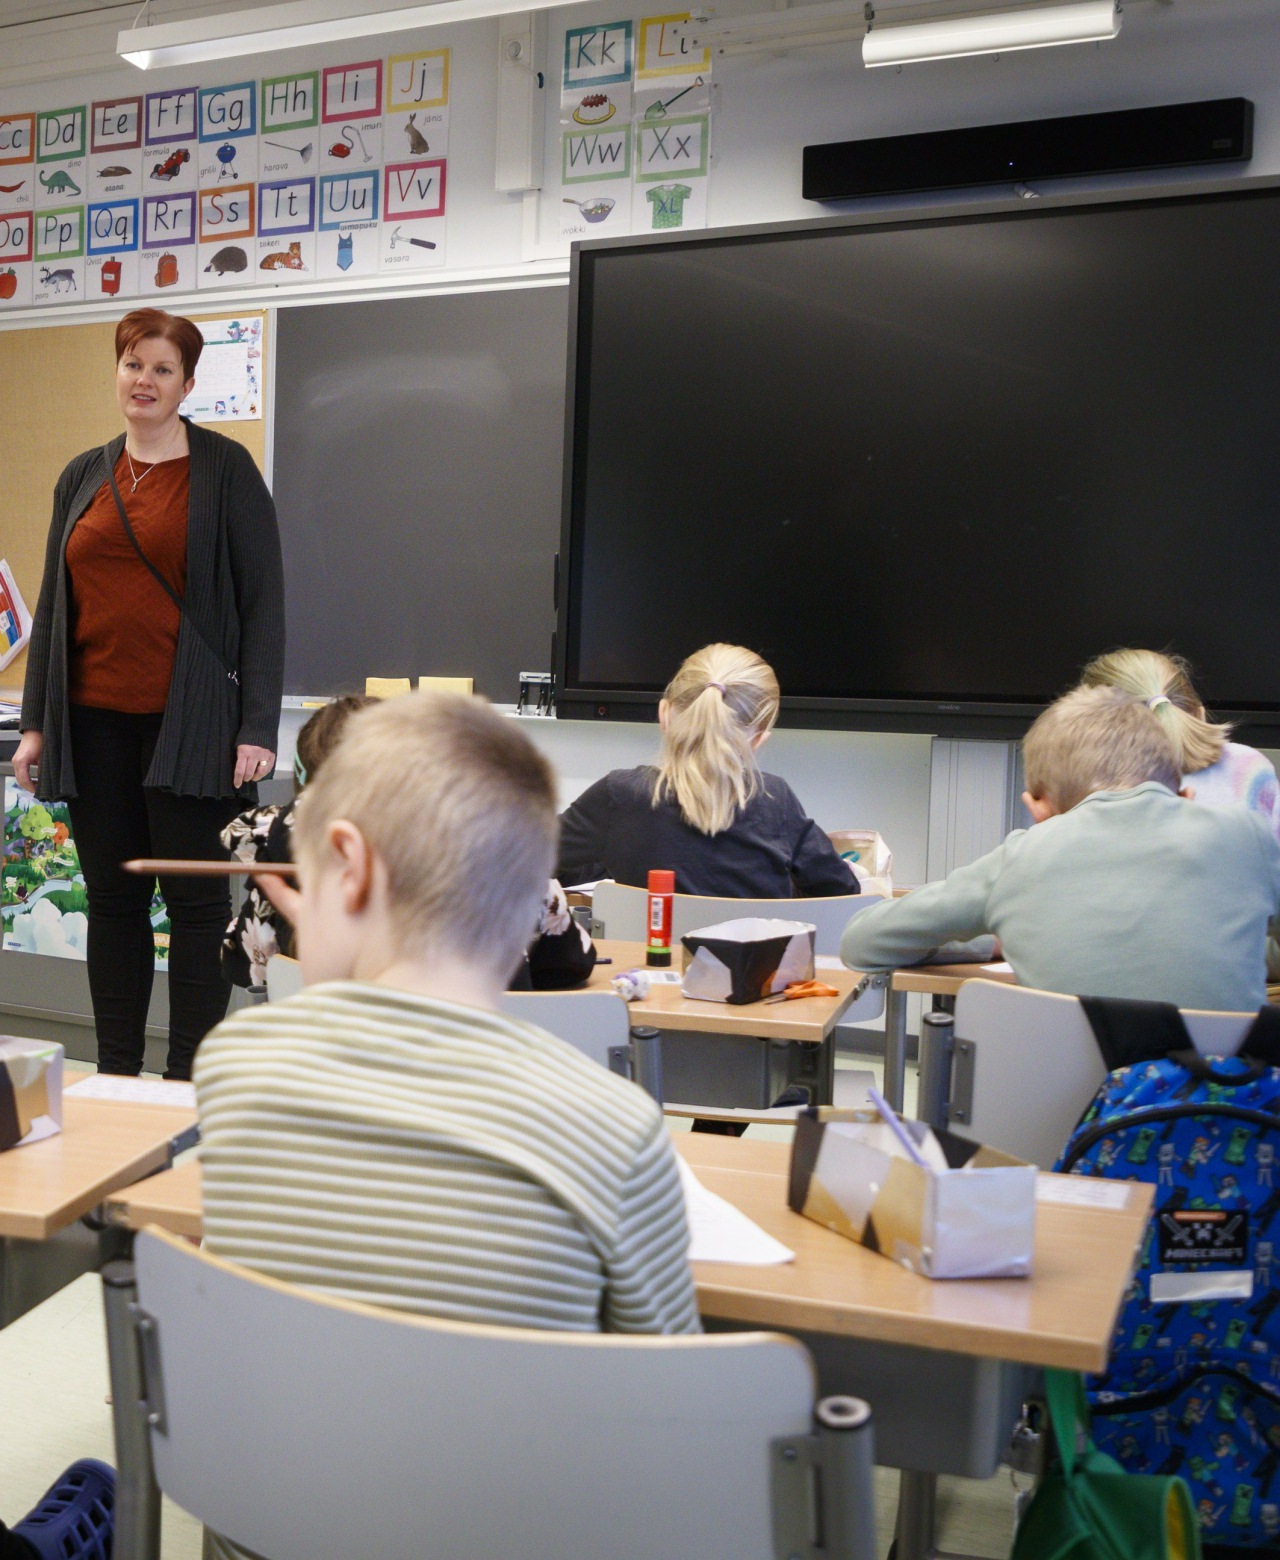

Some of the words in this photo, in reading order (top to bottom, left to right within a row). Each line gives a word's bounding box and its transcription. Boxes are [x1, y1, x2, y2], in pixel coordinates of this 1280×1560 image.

[576, 30, 616, 69] Kk
[270, 80, 307, 116] Hh
[341, 70, 360, 104] Ii
[400, 59, 427, 103] Jj
[101, 106, 129, 137] Ee
[157, 93, 187, 128] Ff
[207, 92, 244, 132] Gg
[44, 112, 77, 147] Dd
[647, 126, 692, 163] Xx
[569, 133, 623, 168] Ww
[270, 185, 299, 219] Tt
[328, 179, 367, 213] Uu
[396, 168, 433, 203] Vv
[153, 200, 184, 232] Rr
[206, 193, 239, 226] Ss
[657, 197, 680, 215] XL
[43, 214, 73, 254] Pp
[94, 207, 129, 246] Qq
